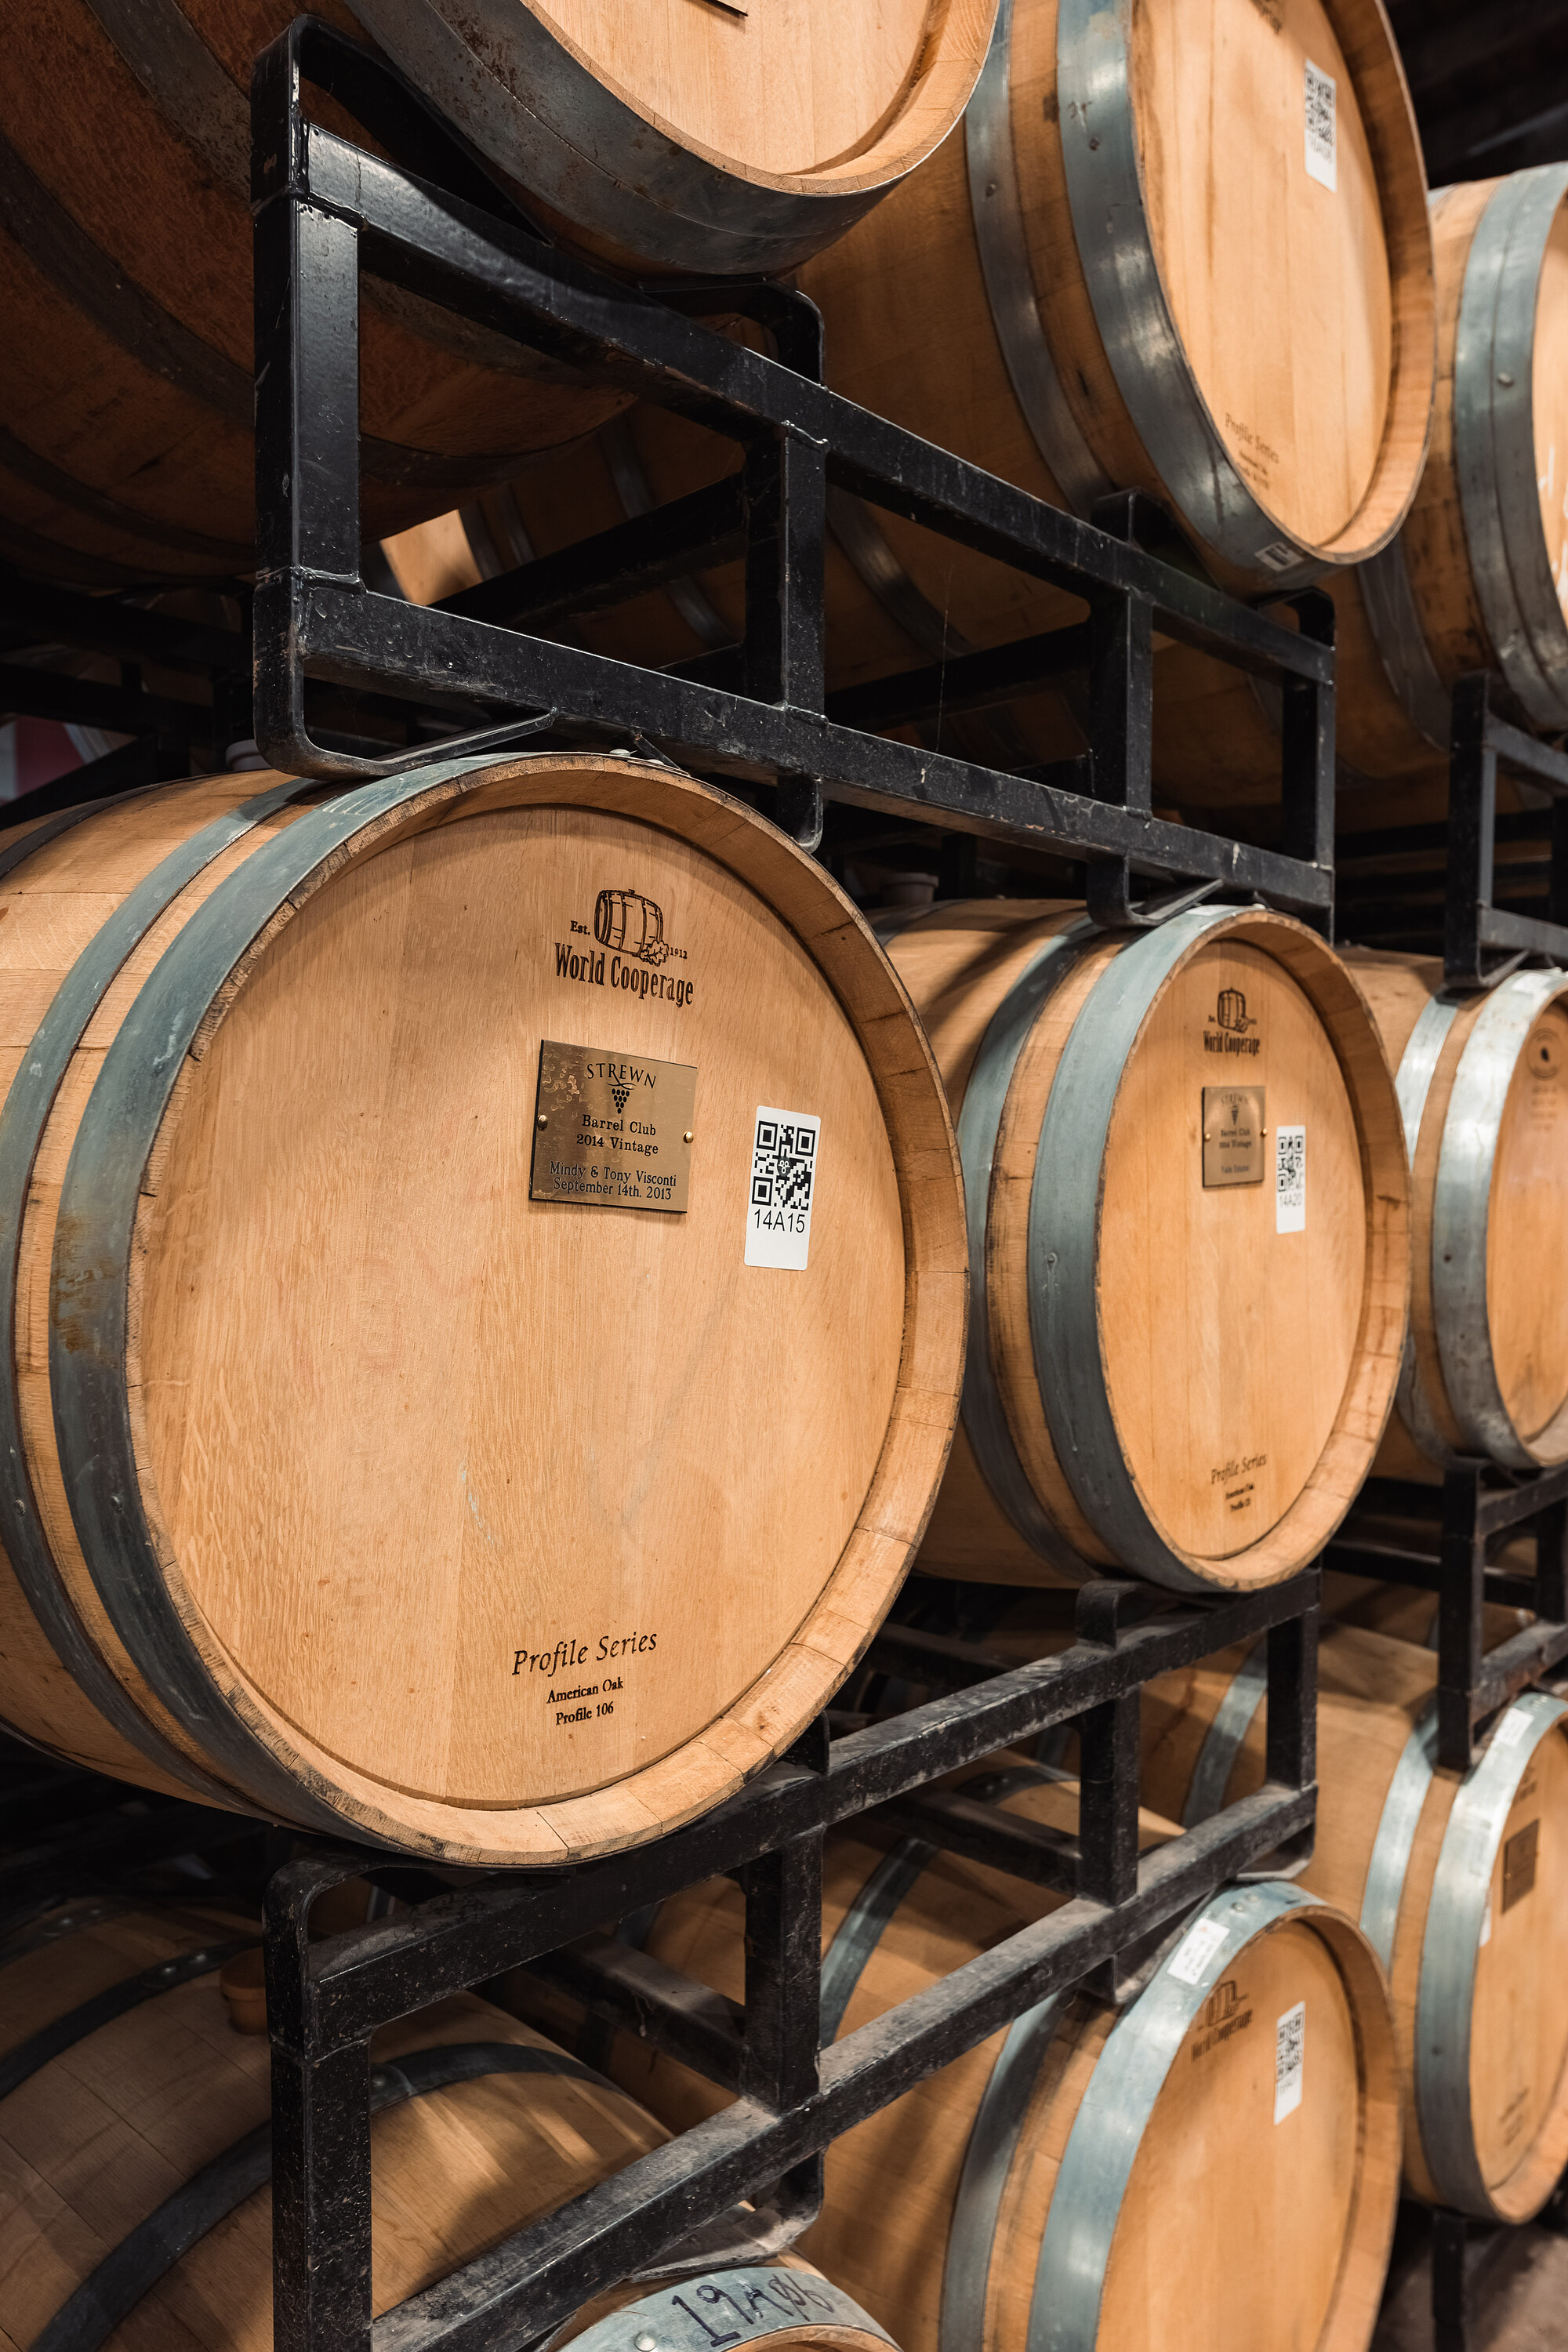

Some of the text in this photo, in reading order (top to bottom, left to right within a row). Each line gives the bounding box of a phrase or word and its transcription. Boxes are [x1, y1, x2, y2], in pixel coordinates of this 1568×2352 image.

[570, 920, 590, 935] Est.
[670, 947, 688, 960] 1912
[554, 942, 694, 1008] World Cooperage
[1203, 1030, 1261, 1057] World Cooperage
[587, 1062, 657, 1090] STREWN
[582, 1114, 657, 1136] Barrel Club
[576, 1134, 659, 1157] 2014 Vintage
[550, 1161, 677, 1187] Mindy & Tony Visconti
[554, 1178, 614, 1194] September
[646, 1187, 673, 1200] 2013
[754, 1208, 806, 1234] 14A15
[512, 1632, 658, 1677] Profile Series
[546, 1676, 624, 1704] American Oak
[555, 1701, 614, 1726] Profile 106
